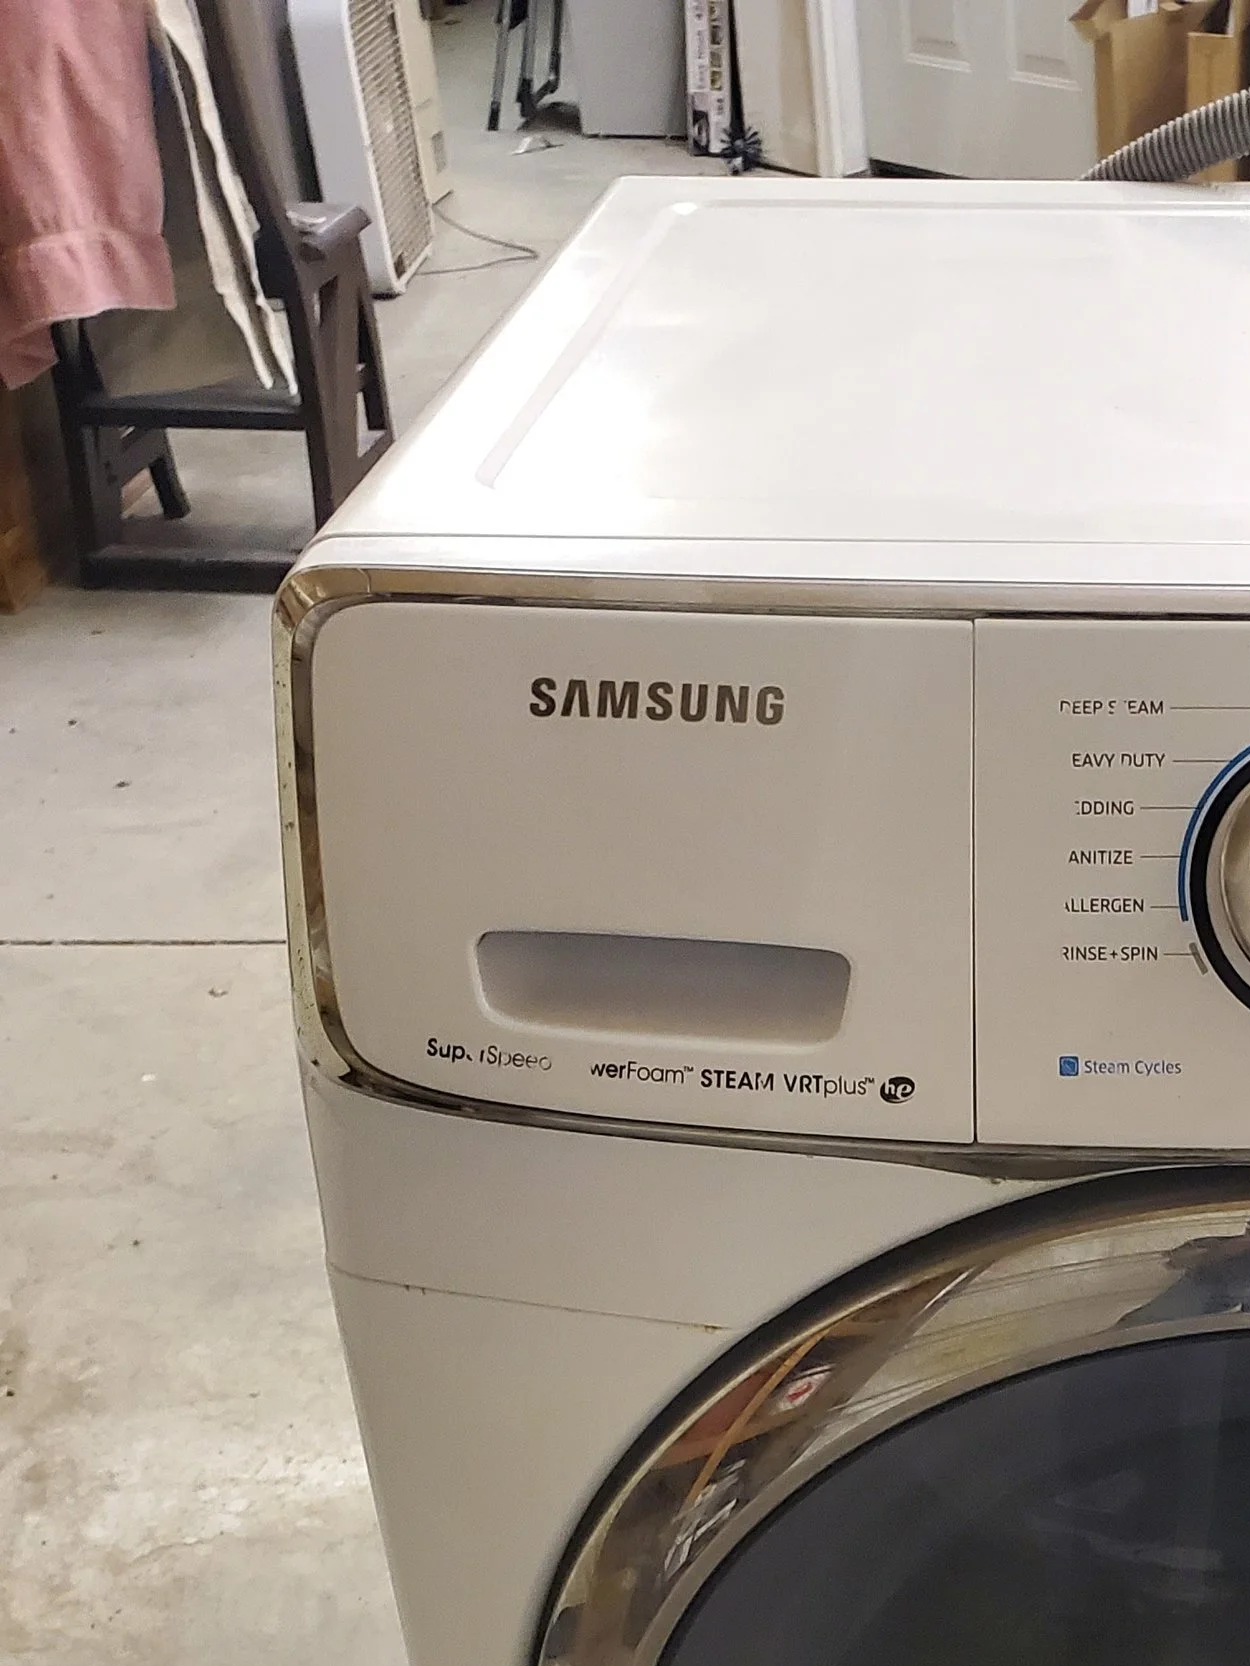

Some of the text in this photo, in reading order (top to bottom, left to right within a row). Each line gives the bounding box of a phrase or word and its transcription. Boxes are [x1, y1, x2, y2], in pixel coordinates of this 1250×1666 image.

[530, 677, 785, 725] SAMSUNG
[1060, 700, 1164, 715] DEEP SEAM
[1072, 753, 1165, 767] EAVY DUTY
[1075, 800, 1135, 815] DDING
[1068, 850, 1133, 864] ANITIZE
[1084, 1060, 1182, 1076] Steam Cycles
[700, 1069, 774, 1091] STEAM
